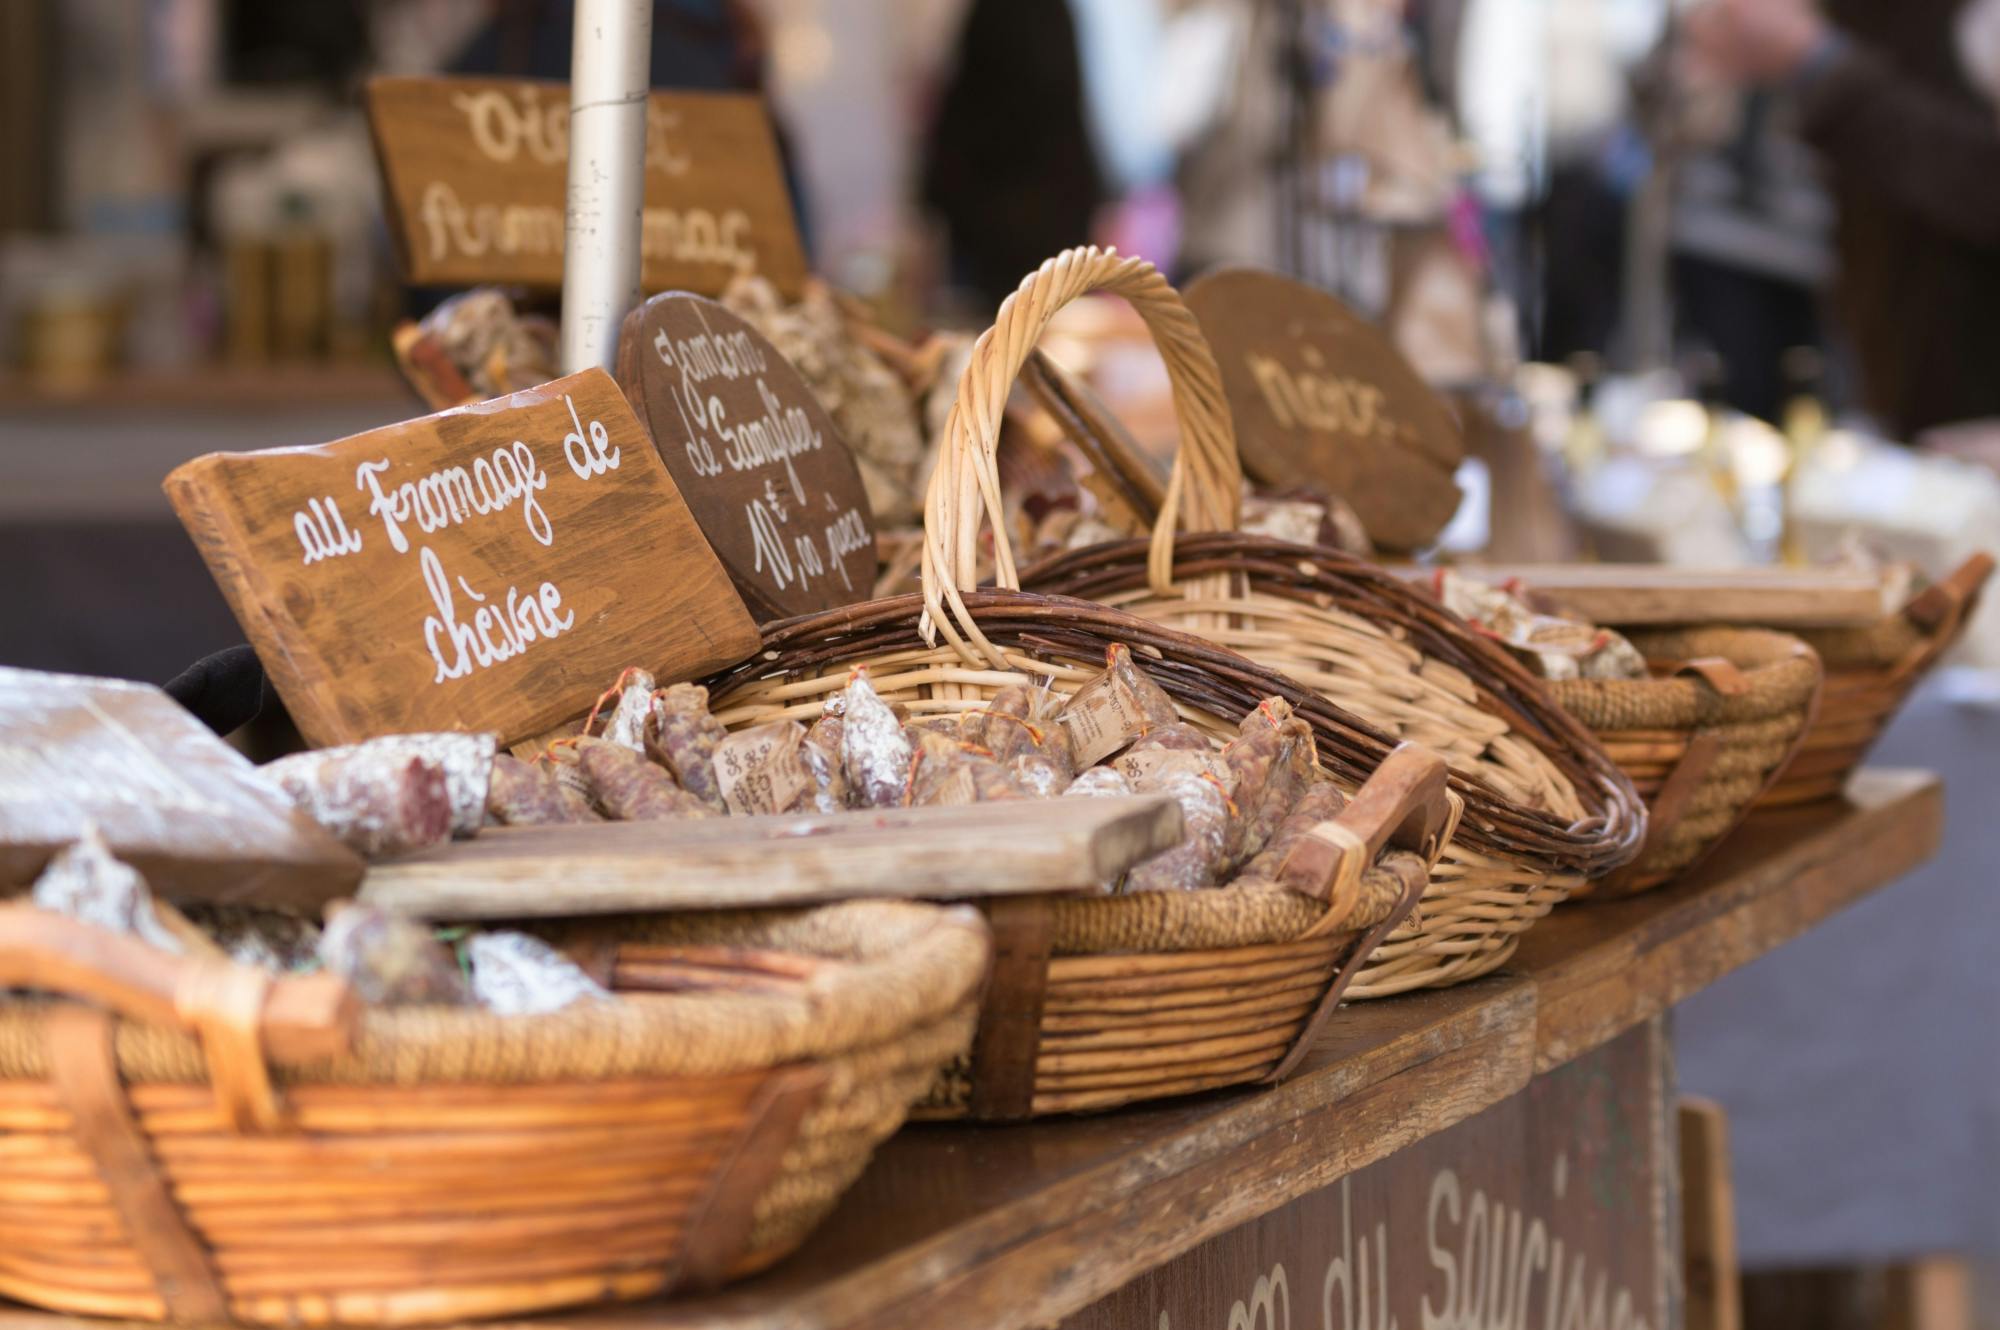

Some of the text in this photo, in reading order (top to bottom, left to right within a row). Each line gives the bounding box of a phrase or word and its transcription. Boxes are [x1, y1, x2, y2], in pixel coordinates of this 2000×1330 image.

[654, 299, 767, 430] Jambon
[671, 385, 722, 477] de
[294, 394, 621, 565] au Fromage de
[420, 546, 574, 683] chèvre
